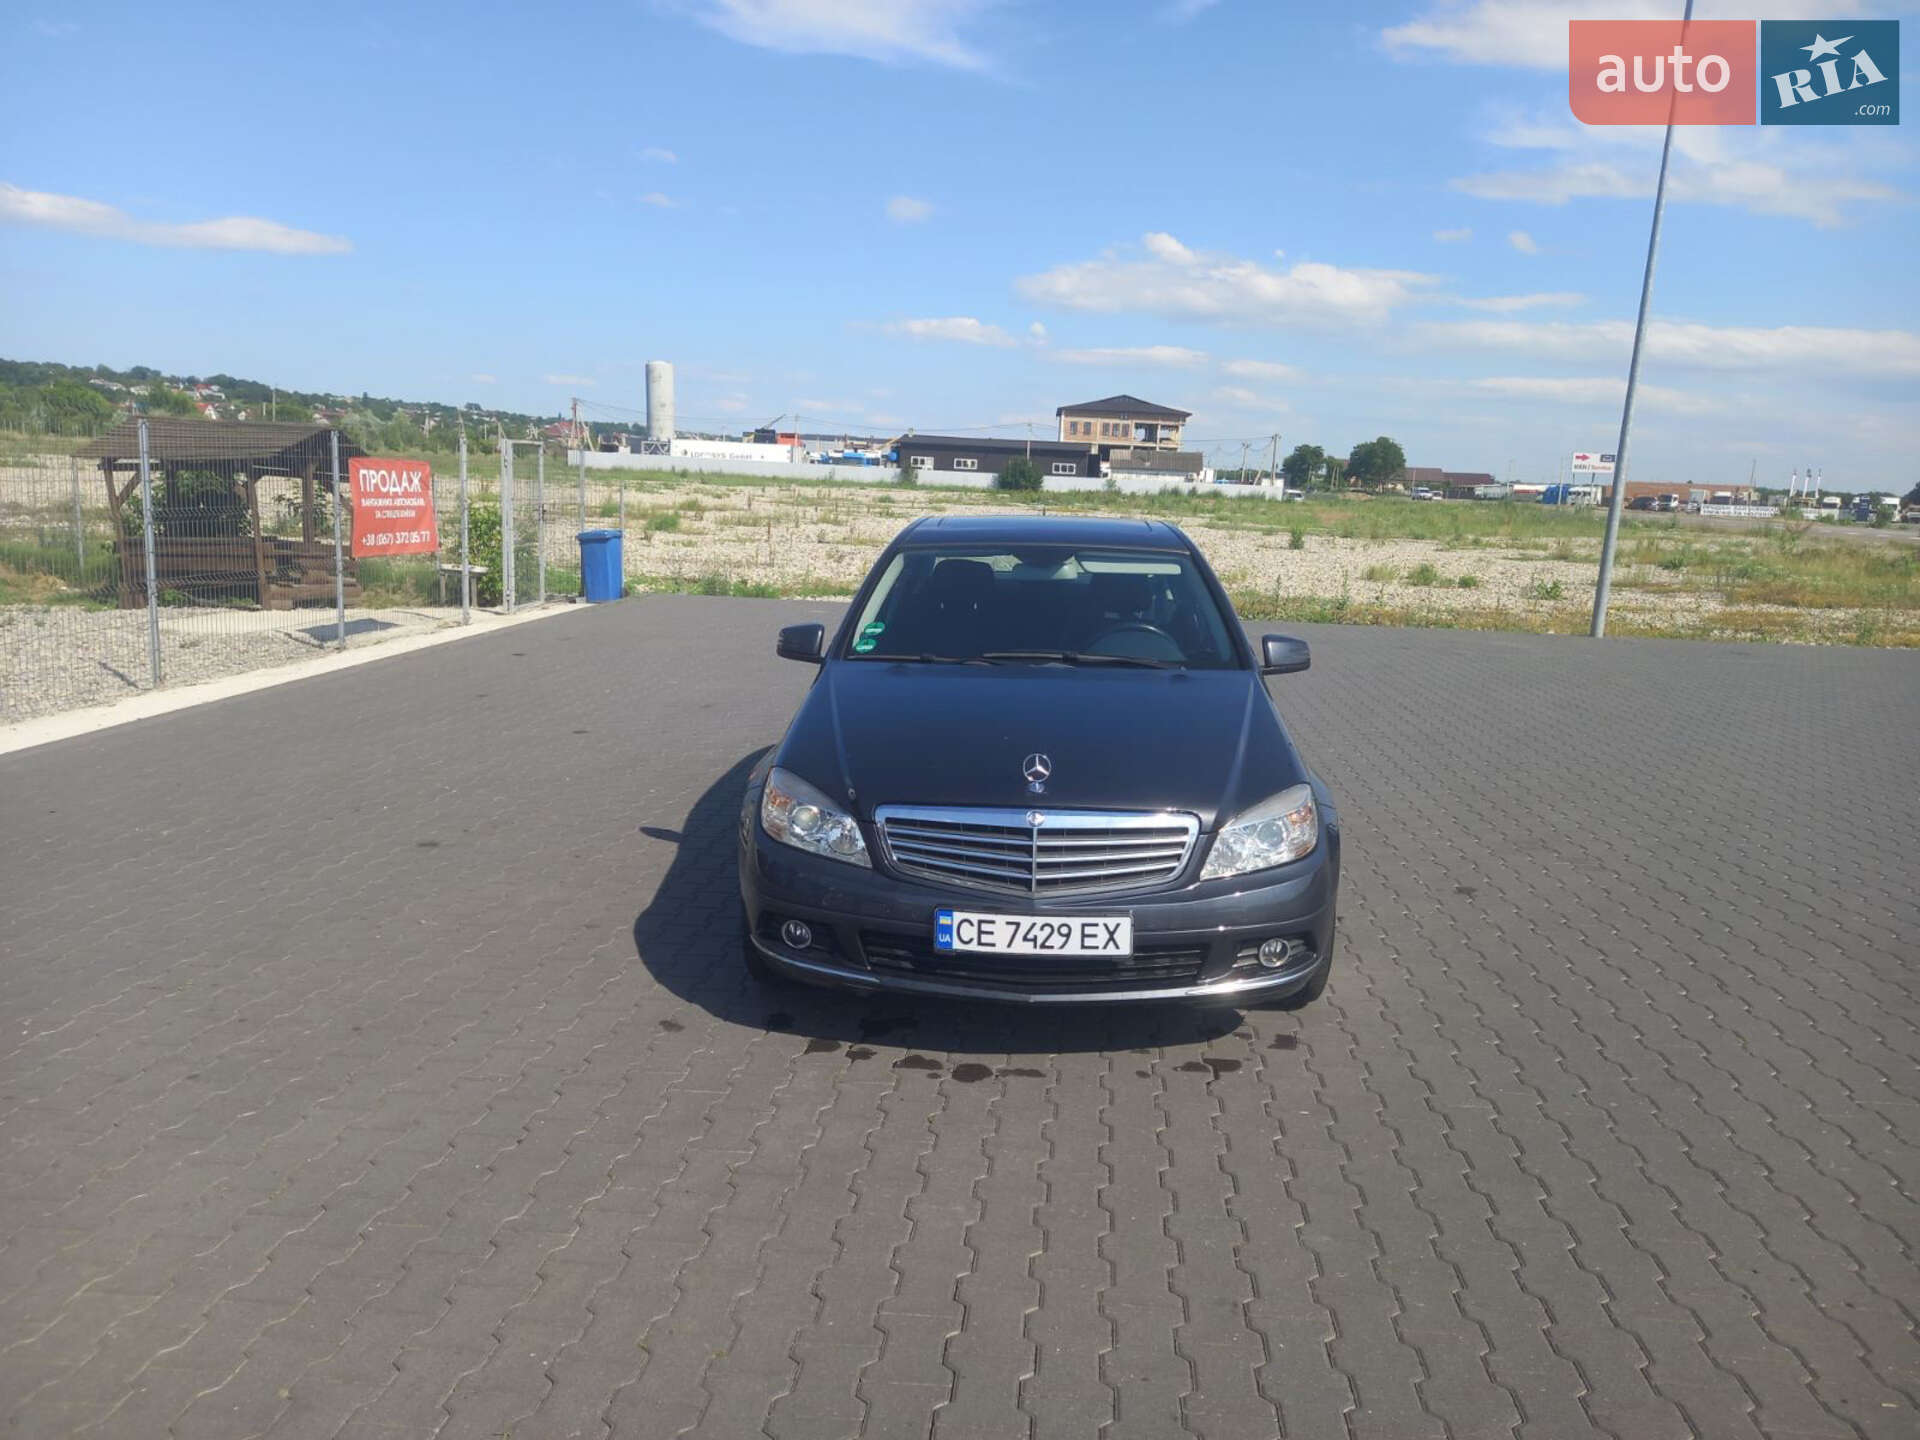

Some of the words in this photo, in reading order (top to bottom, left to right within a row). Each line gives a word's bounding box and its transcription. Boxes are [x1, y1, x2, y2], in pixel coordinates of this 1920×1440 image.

[359, 468, 422, 496] ПРОДАЖ
[362, 533, 376, 546] +38
[938, 932, 952, 944] UA
[955, 917, 997, 948] CE
[1004, 920, 1073, 950] 7429
[1079, 922, 1122, 951] EX
